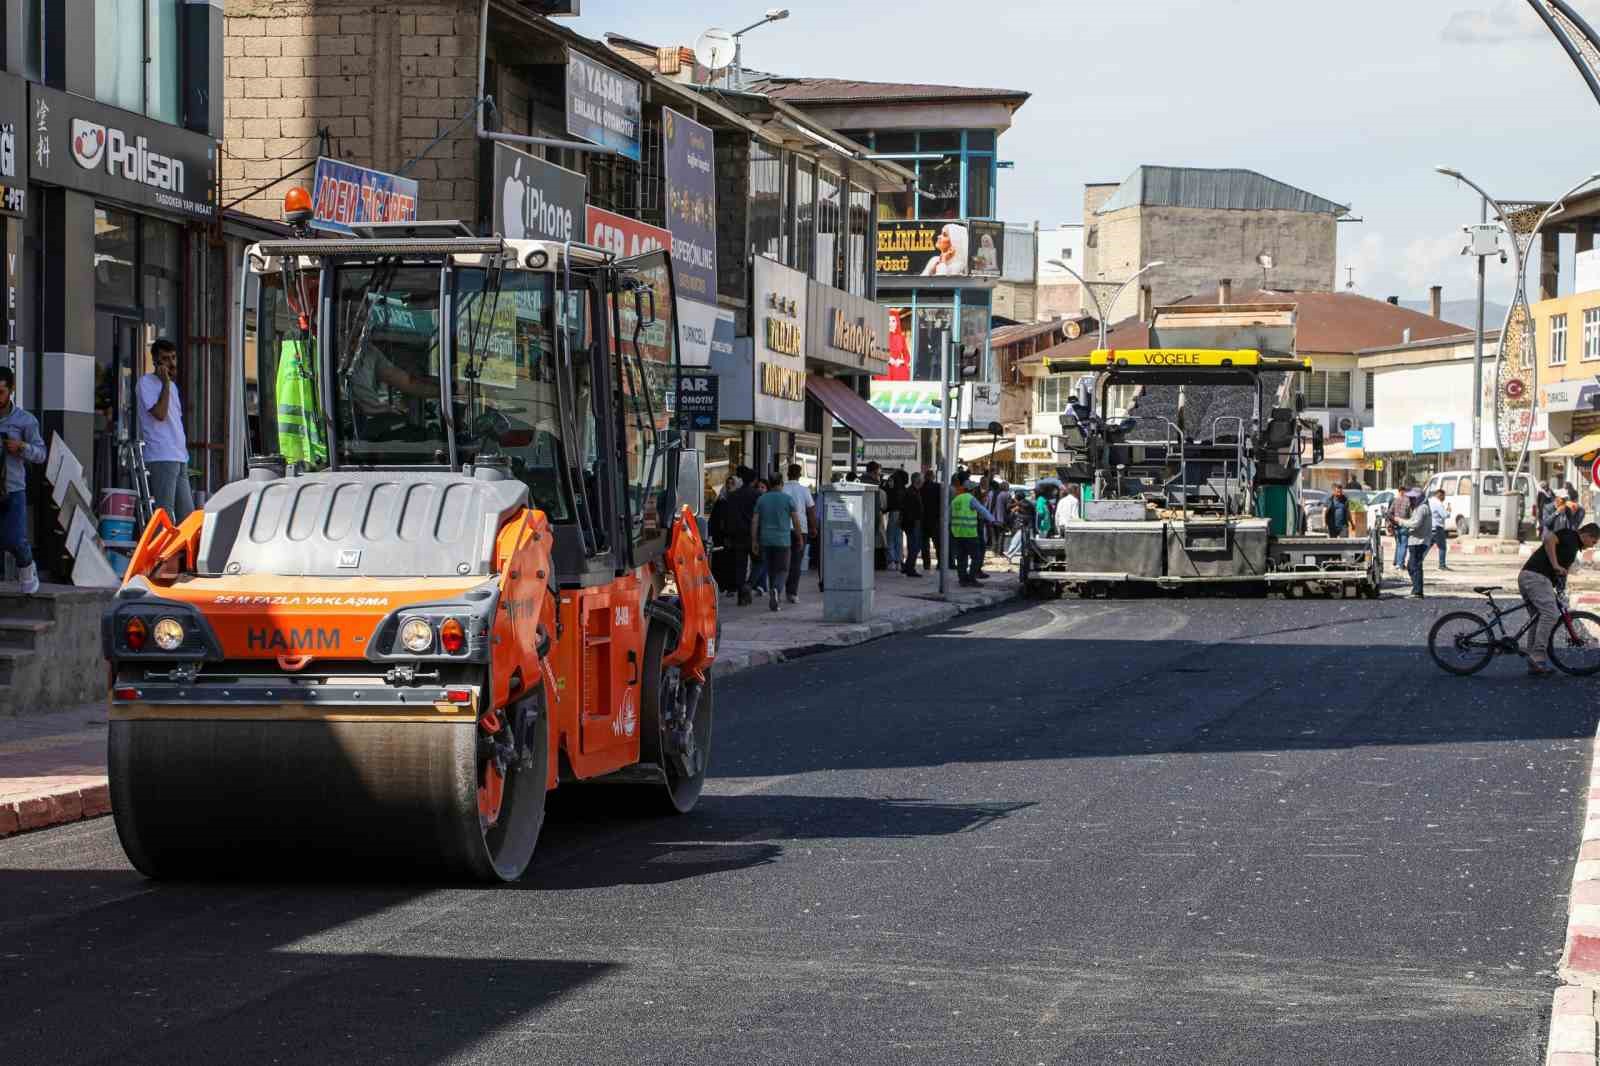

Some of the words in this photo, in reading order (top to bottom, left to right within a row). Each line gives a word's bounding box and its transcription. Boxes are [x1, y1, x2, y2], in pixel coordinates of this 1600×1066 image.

[106, 127, 184, 194] Polisan
[525, 176, 572, 240] iPhone
[878, 224, 936, 251] ELİNLİK
[875, 256, 909, 272] FÖRÜ
[681, 378, 708, 391] AR
[681, 395, 714, 404] OMOTIV
[214, 595, 235, 604] 25
[252, 595, 301, 605] FAZLA
[304, 596, 389, 606] YAKLAŞMA
[247, 626, 341, 650] HAMM
